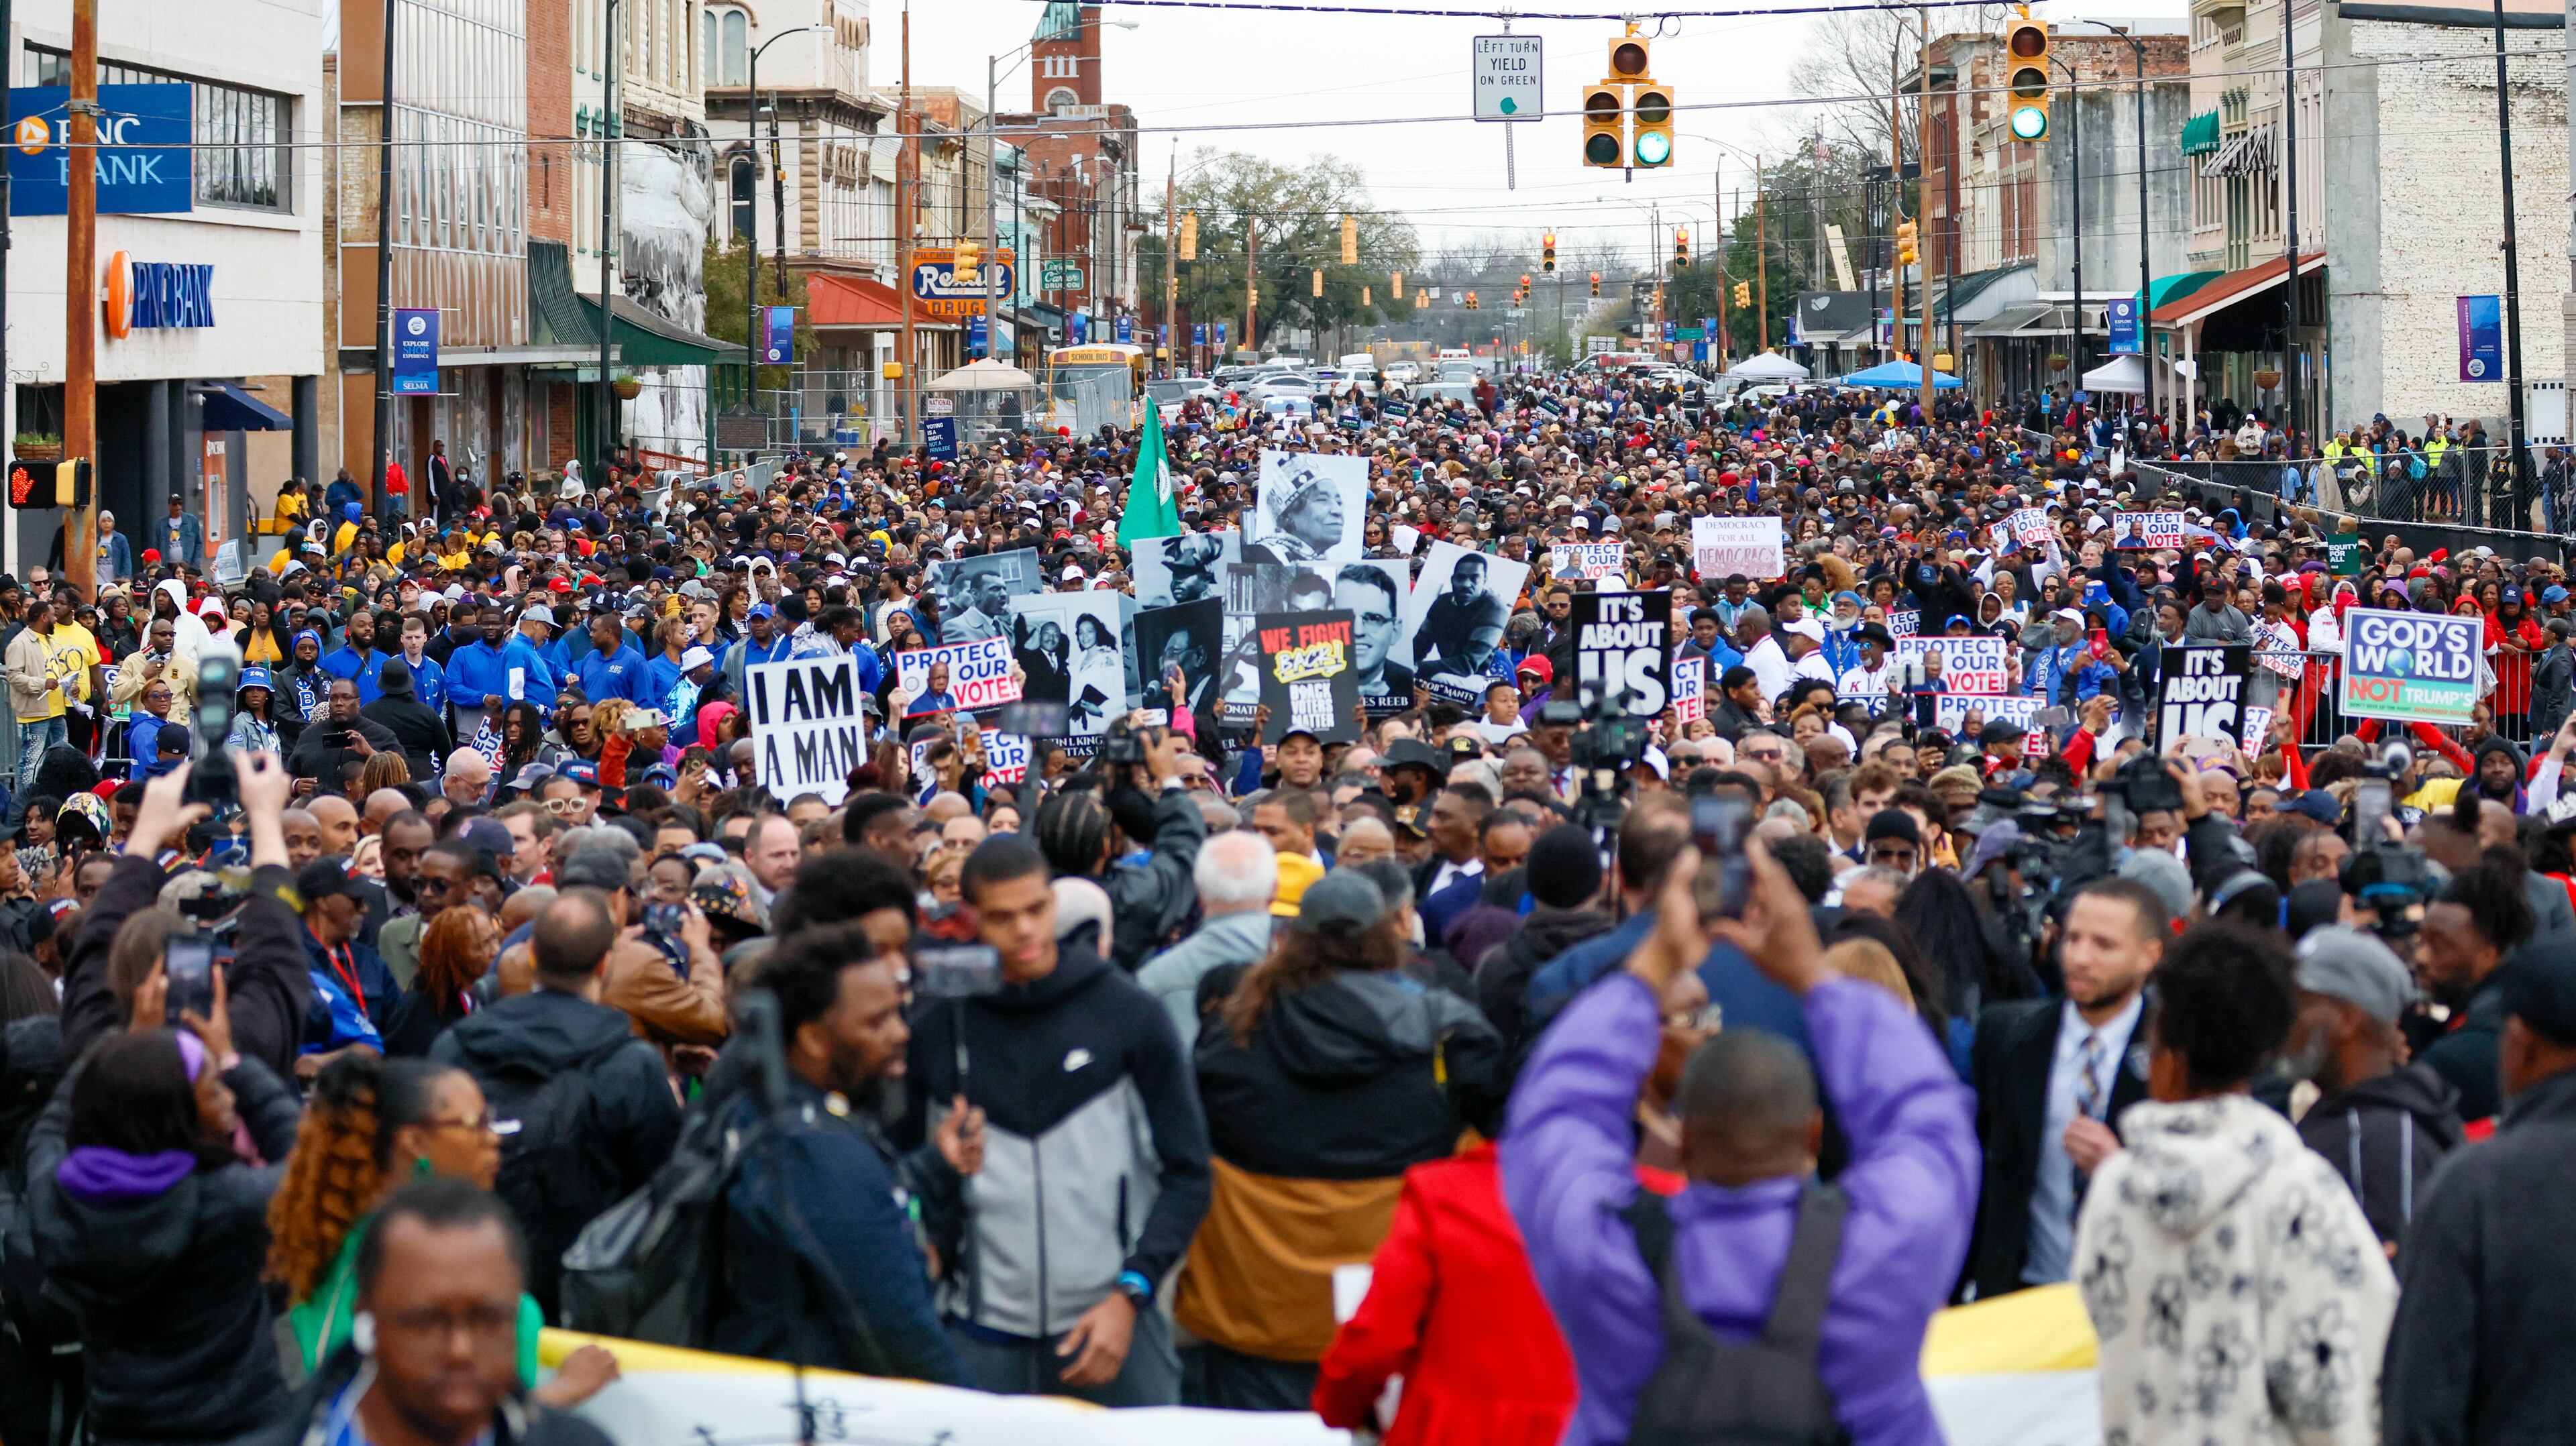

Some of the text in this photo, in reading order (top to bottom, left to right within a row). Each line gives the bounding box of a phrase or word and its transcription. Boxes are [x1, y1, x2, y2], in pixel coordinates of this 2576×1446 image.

[1478, 43, 1538, 53] LEFT TURN
[1491, 58, 1526, 70] YIELD
[1481, 75, 1536, 85] ON GREEN
[918, 266, 1006, 296] Reall
[1044, 271, 1079, 282] Carer
[136, 262, 216, 328] PNC BANK
[932, 301, 988, 315] DRUG
[403, 346, 429, 354] SHOP
[1071, 353, 1108, 362] SCHOOL BUS
[926, 422, 944, 430] VOTING
[929, 445, 951, 453] PRIVILEGE
[1705, 521, 1768, 529] DEMOCRACY
[1993, 510, 2045, 535] PROTECT
[2019, 518, 2045, 531] OUR
[2116, 513, 2182, 523] PROTECT
[2149, 524, 2179, 534] OUR
[1717, 534, 1757, 542] FOR ALL
[1554, 544, 1621, 555] PROTECT
[2328, 543, 2358, 551] EQUITY
[1588, 555, 1618, 565] OUR
[1699, 547, 1777, 565] DEMOCRACY
[1585, 565, 1622, 577] VOT
[1599, 596, 1644, 622] IT'S
[1888, 611, 1921, 624] TECT
[1260, 620, 1352, 655] WE FIGHT
[1579, 621, 1664, 649] ABOUT
[2361, 617, 2469, 653] GOD'S
[1900, 639, 2002, 655] PROTECT
[902, 640, 1006, 671] PROTECT
[1278, 641, 1344, 674] BACK!
[1951, 656, 1998, 670] OUR
[2186, 649, 2224, 676] IT'S
[959, 659, 1006, 681] OUR
[2265, 655, 2300, 678] VOTE!
[1578, 647, 1666, 716] US
[1672, 681, 1697, 698] UR
[1849, 681, 1862, 693] K
[1947, 672, 2005, 691] VOTE!
[2165, 675, 2242, 704] ABOUT
[754, 663, 854, 725] I AM
[953, 676, 1018, 706] VOTE!
[1444, 686, 1474, 702] MANTS
[2349, 676, 2473, 708] NOT TRUMP'S
[1291, 698, 1334, 715] VOTERS
[1379, 696, 1409, 706] REEB
[1676, 697, 1703, 720] TE!
[1941, 697, 2043, 714] PROTECT
[1291, 713, 1335, 728] MATTER
[2161, 701, 2238, 757] US
[1076, 736, 1103, 746] KING
[765, 726, 859, 788] A MAN
[990, 748, 1024, 767] UR
